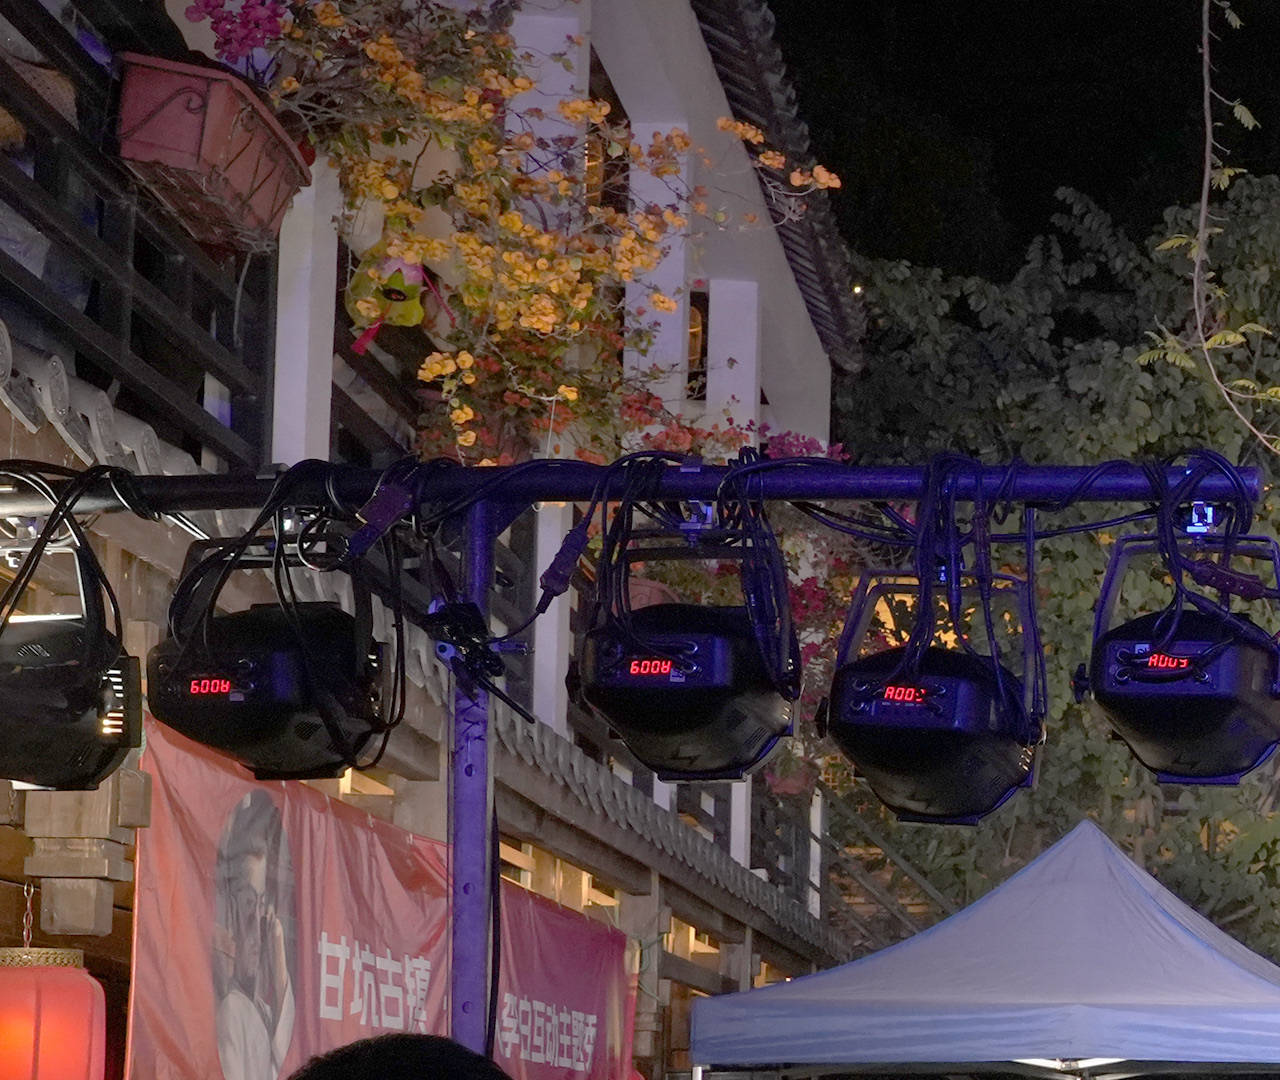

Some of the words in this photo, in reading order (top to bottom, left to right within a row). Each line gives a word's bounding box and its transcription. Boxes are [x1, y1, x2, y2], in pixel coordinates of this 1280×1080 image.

[496, 992, 597, 1073] 李白互动主题秀
